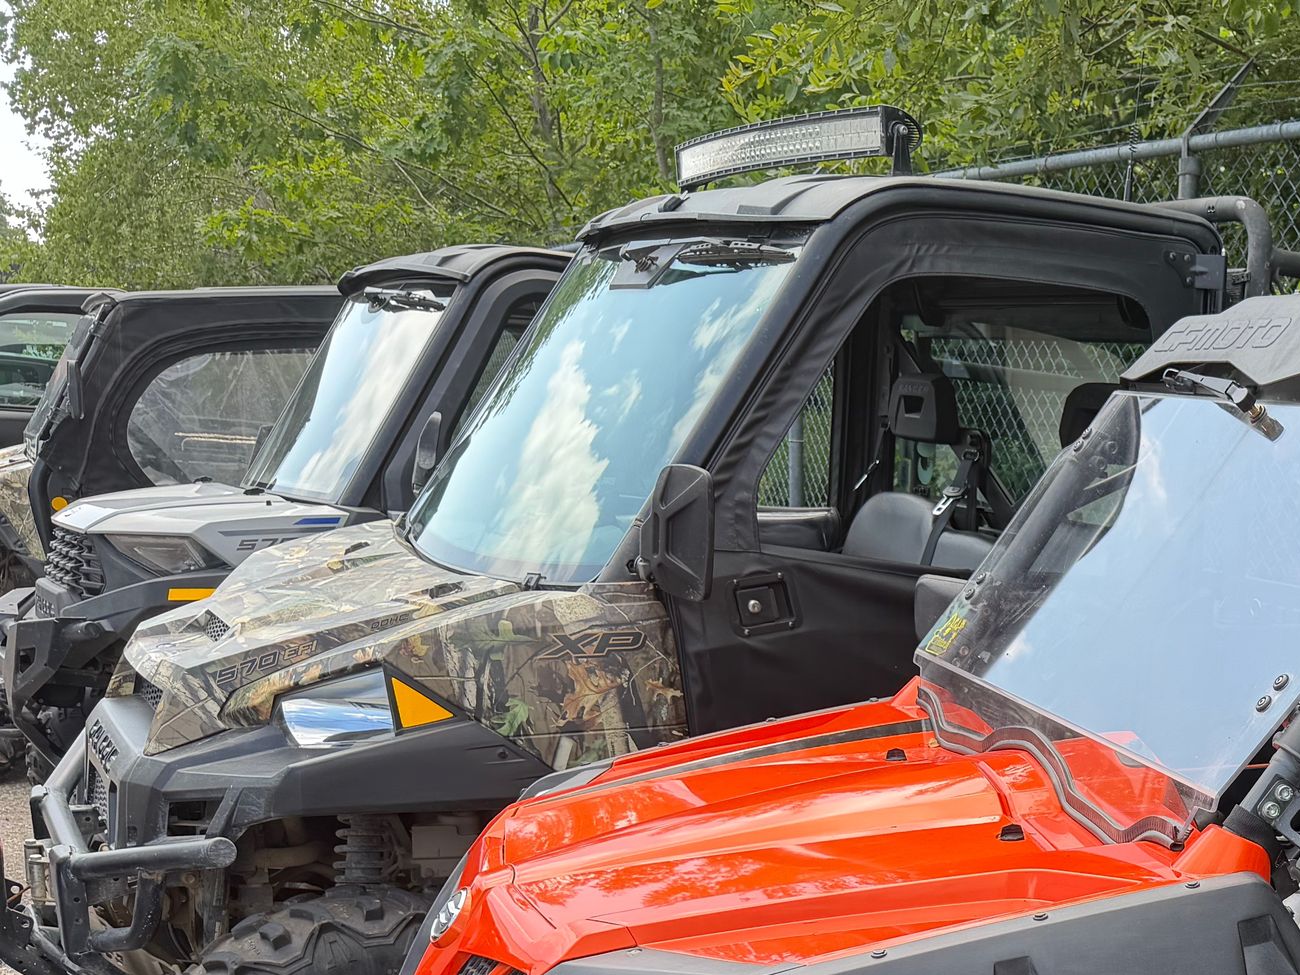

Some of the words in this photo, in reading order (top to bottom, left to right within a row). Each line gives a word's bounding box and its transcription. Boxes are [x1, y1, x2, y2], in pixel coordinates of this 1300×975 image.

[1154, 317, 1293, 352] CFMOTO
[236, 536, 300, 551] 57
[533, 630, 646, 660] XP
[217, 651, 279, 684] 570
[283, 640, 319, 661] EFI
